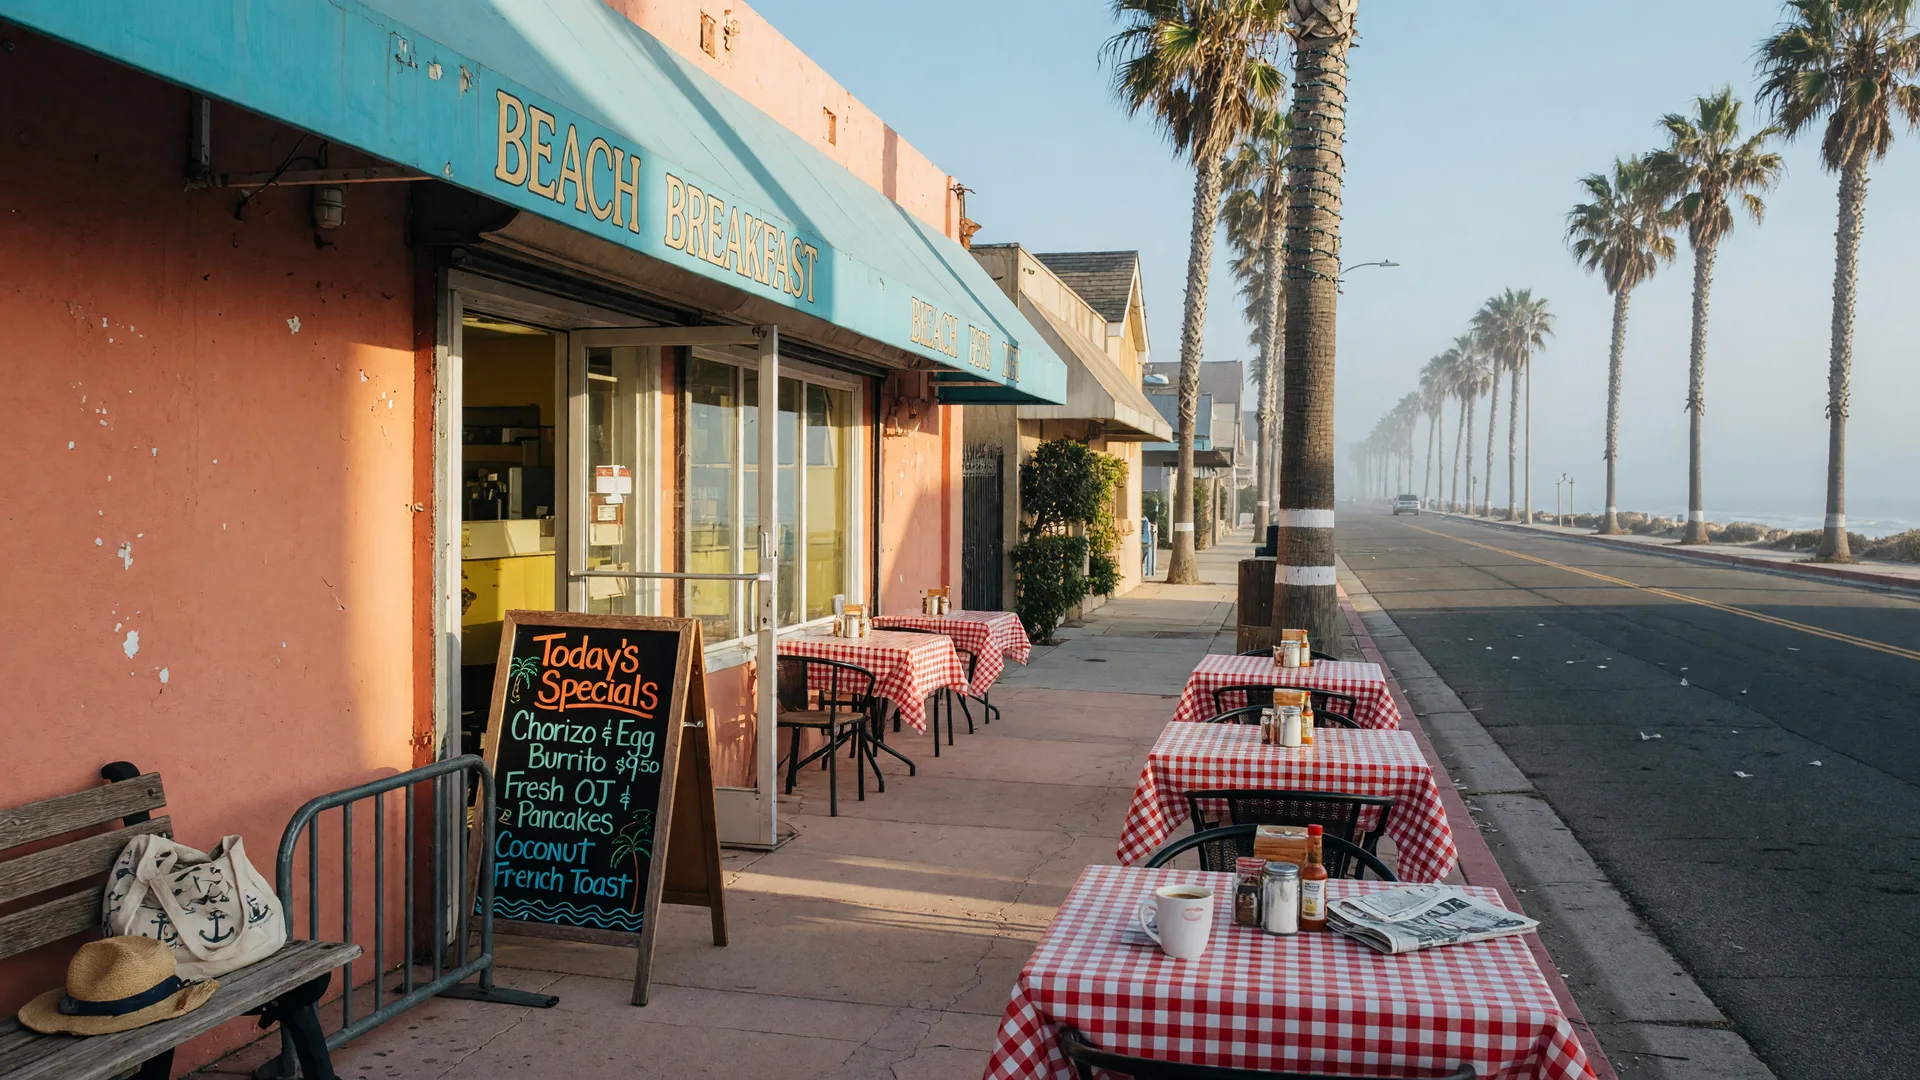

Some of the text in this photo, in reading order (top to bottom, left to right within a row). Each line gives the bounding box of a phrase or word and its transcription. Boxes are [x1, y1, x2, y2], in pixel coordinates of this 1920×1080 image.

[495, 88, 818, 304] BEACH BREAKFAST
[533, 633, 639, 680] Today's
[537, 669, 659, 713] Specials
[511, 709, 597, 744] Chorizo
[616, 719, 656, 758] Egg
[528, 743, 660, 782] Burrito $9.50
[504, 771, 565, 802] Fresh
[575, 779, 616, 807] OJ
[518, 801, 613, 835] Pancakes
[571, 868, 633, 899] Toast
